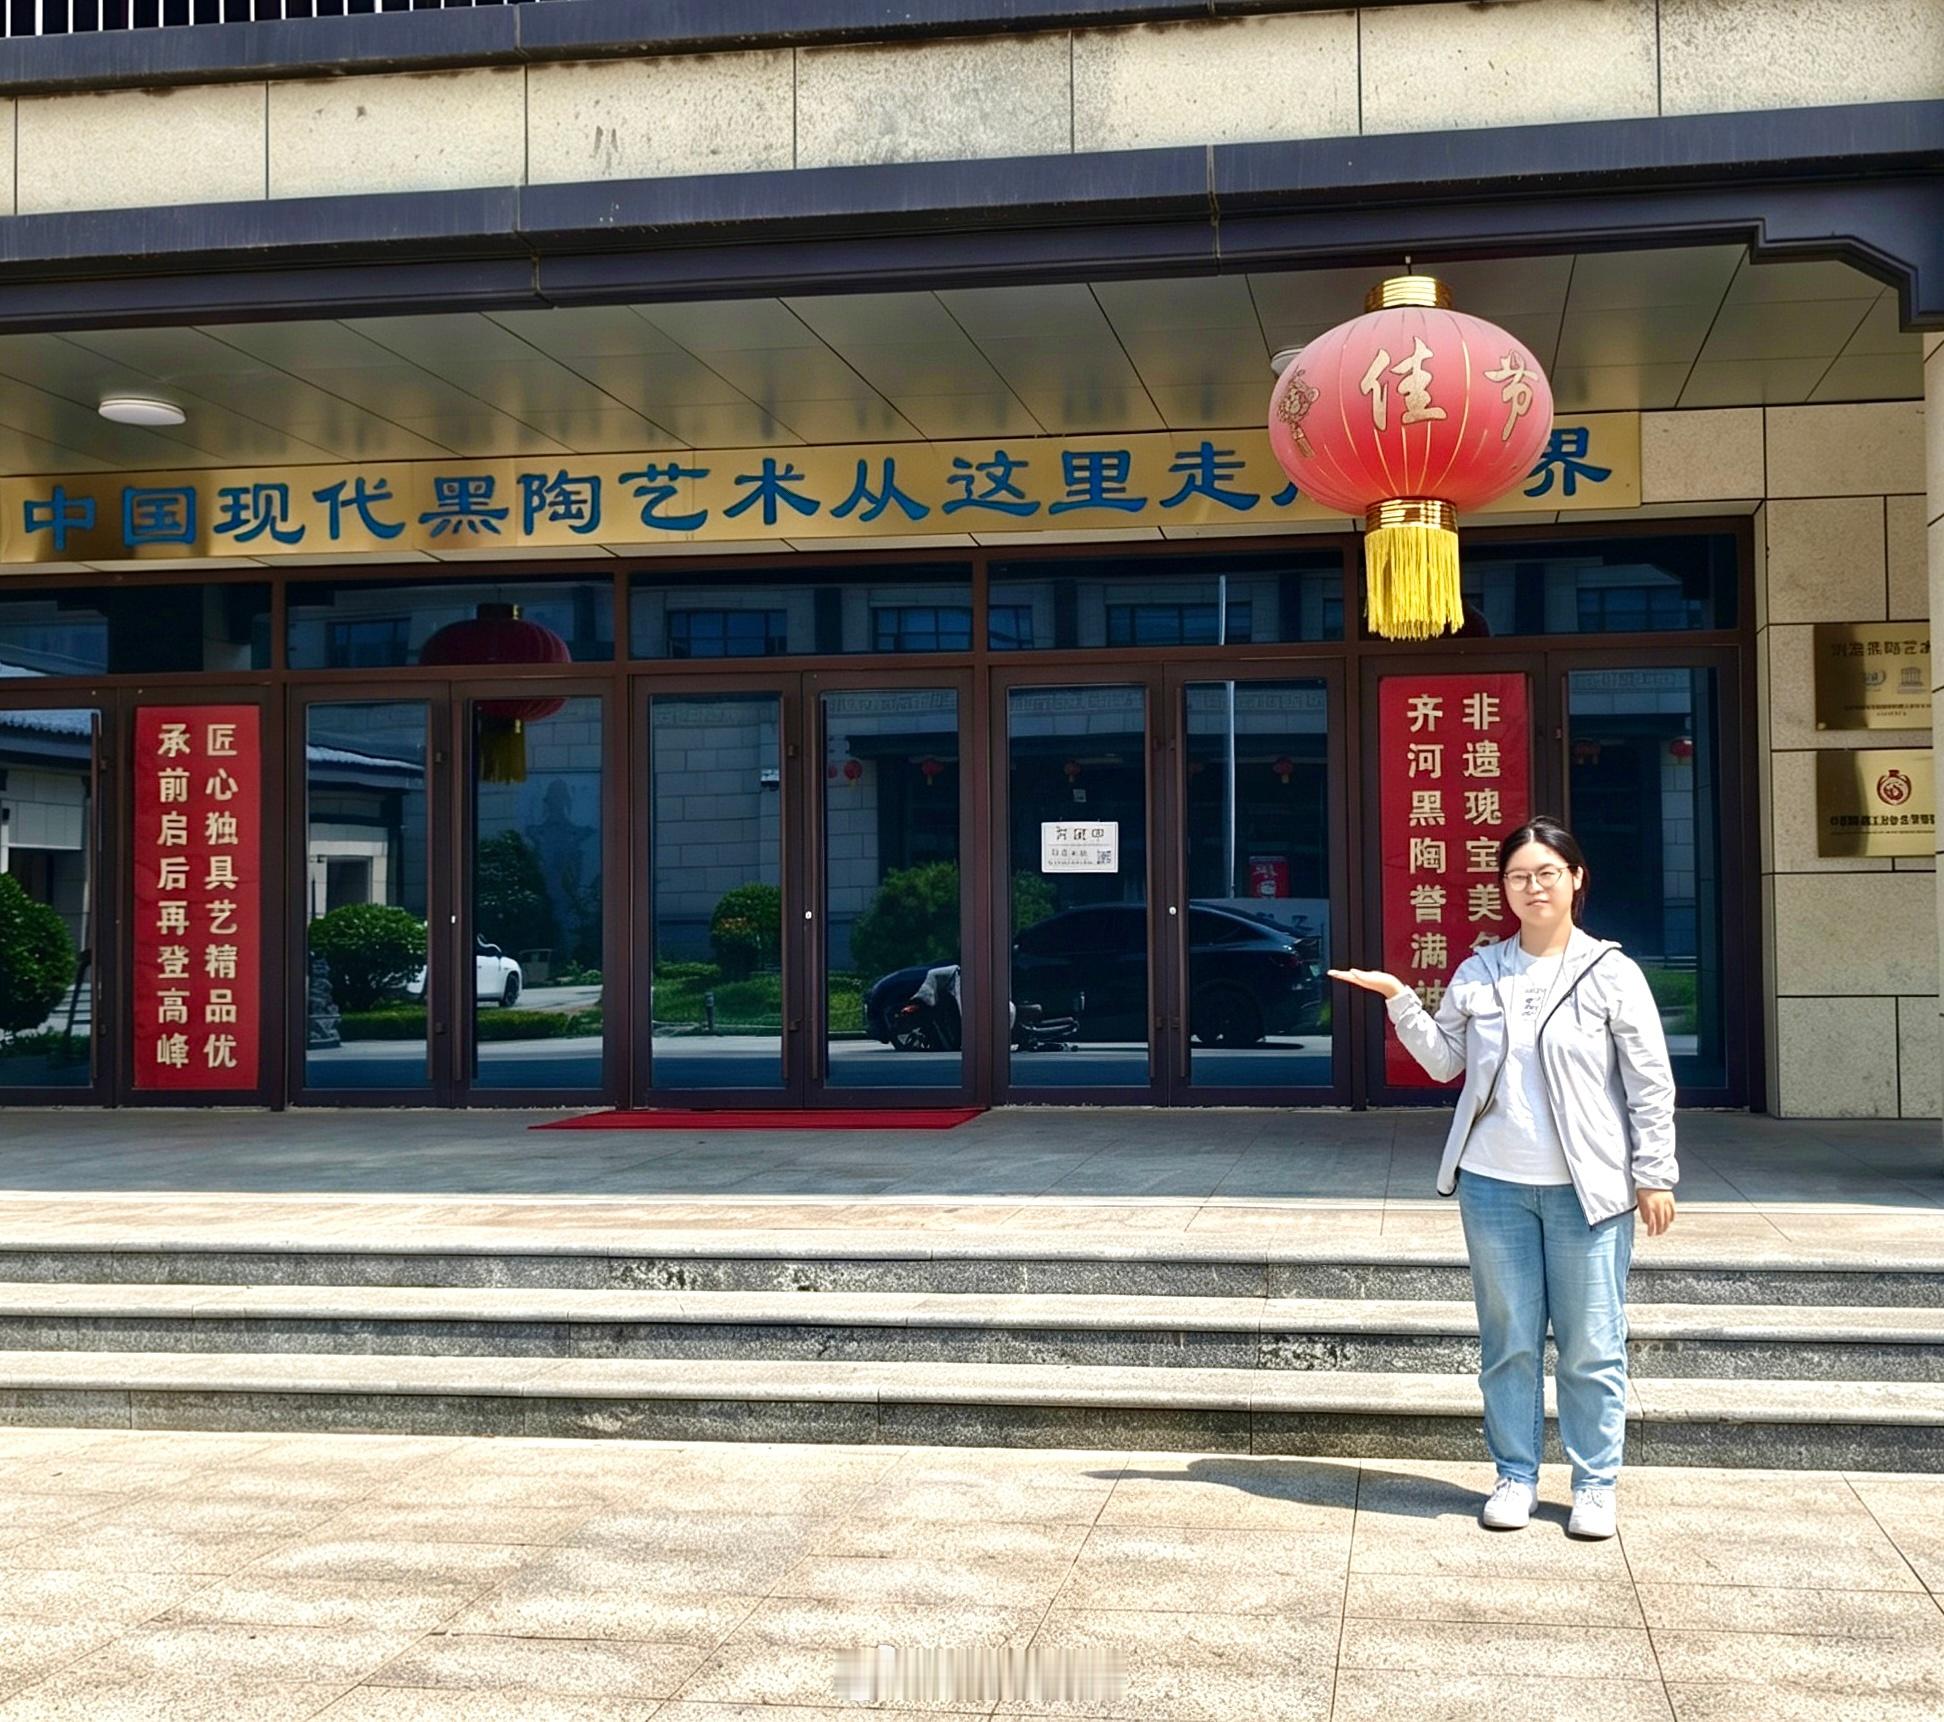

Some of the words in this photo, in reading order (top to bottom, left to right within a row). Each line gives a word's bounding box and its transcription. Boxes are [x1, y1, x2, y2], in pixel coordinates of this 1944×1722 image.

[156, 723, 191, 1069] 承前启后再登高峰
[203, 723, 240, 1069] 匠心独具艺精品优
